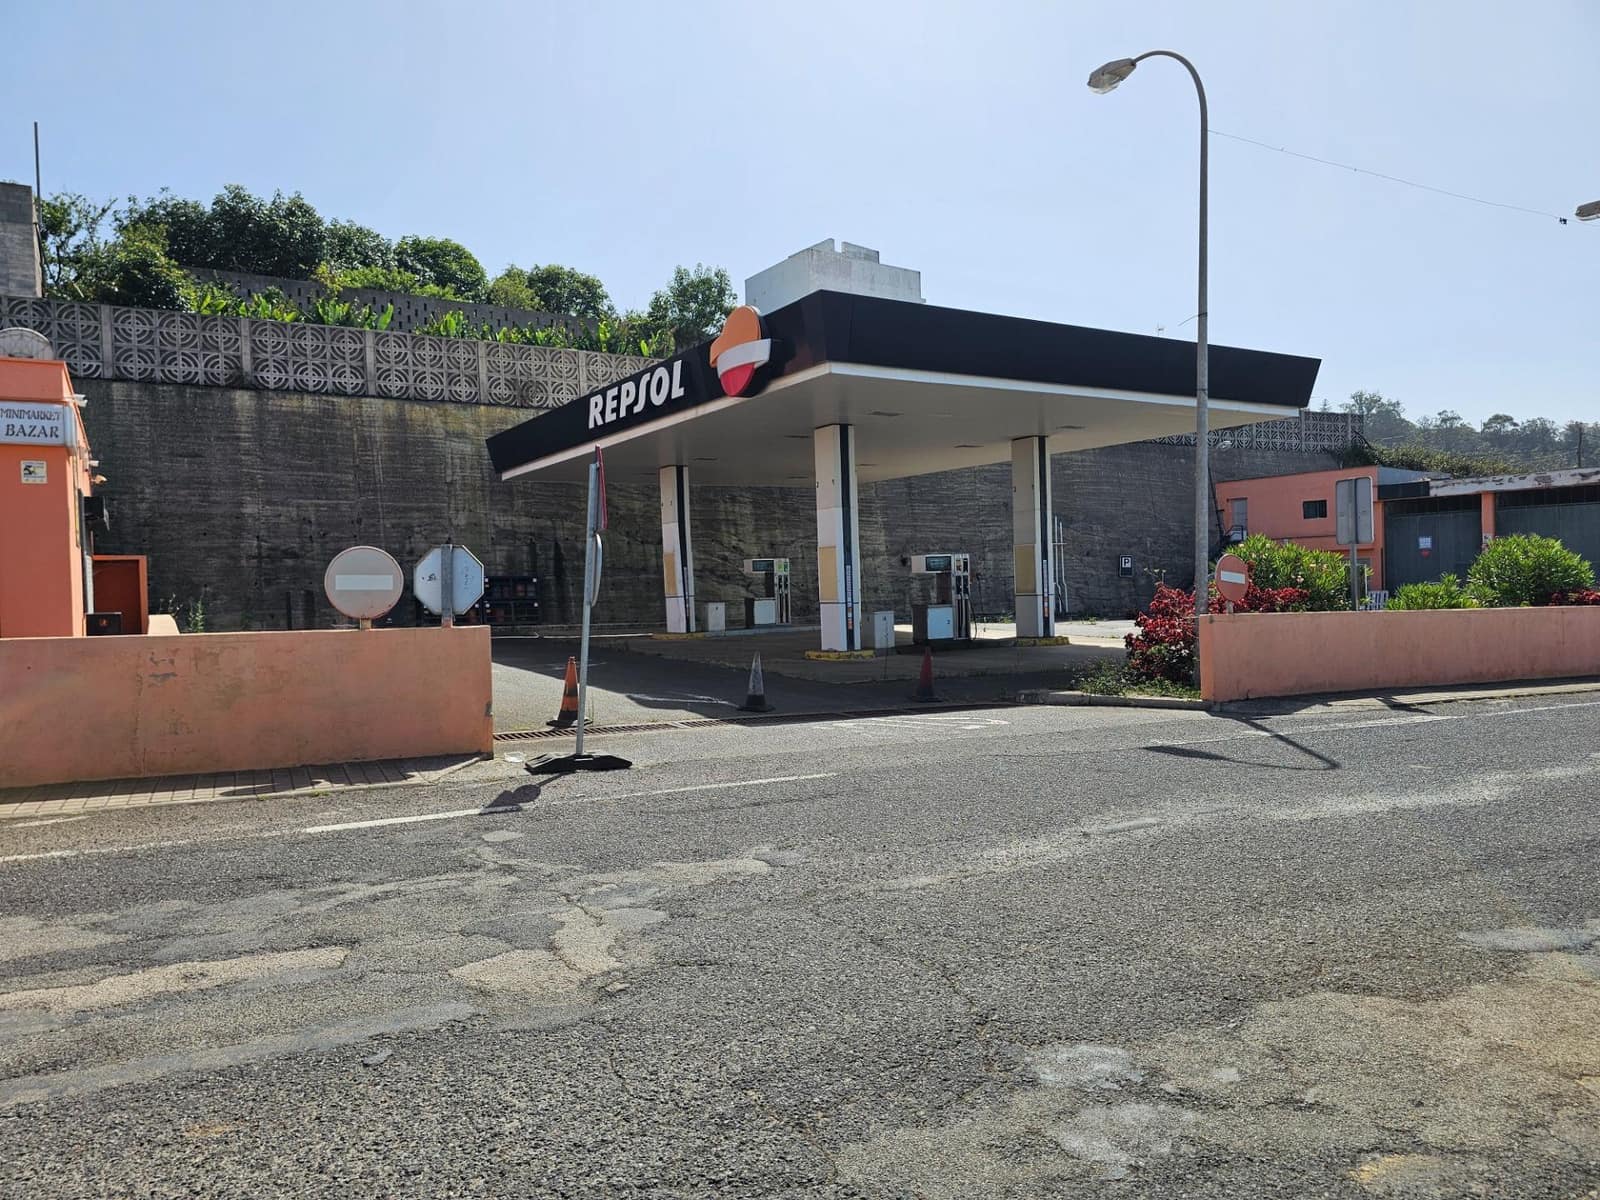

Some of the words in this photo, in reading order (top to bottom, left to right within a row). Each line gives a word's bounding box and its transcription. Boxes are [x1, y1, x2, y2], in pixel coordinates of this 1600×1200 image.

[588, 360, 685, 429] REPSOL
[0, 408, 62, 421] MINIMARKET
[5, 424, 60, 438] BAZAR
